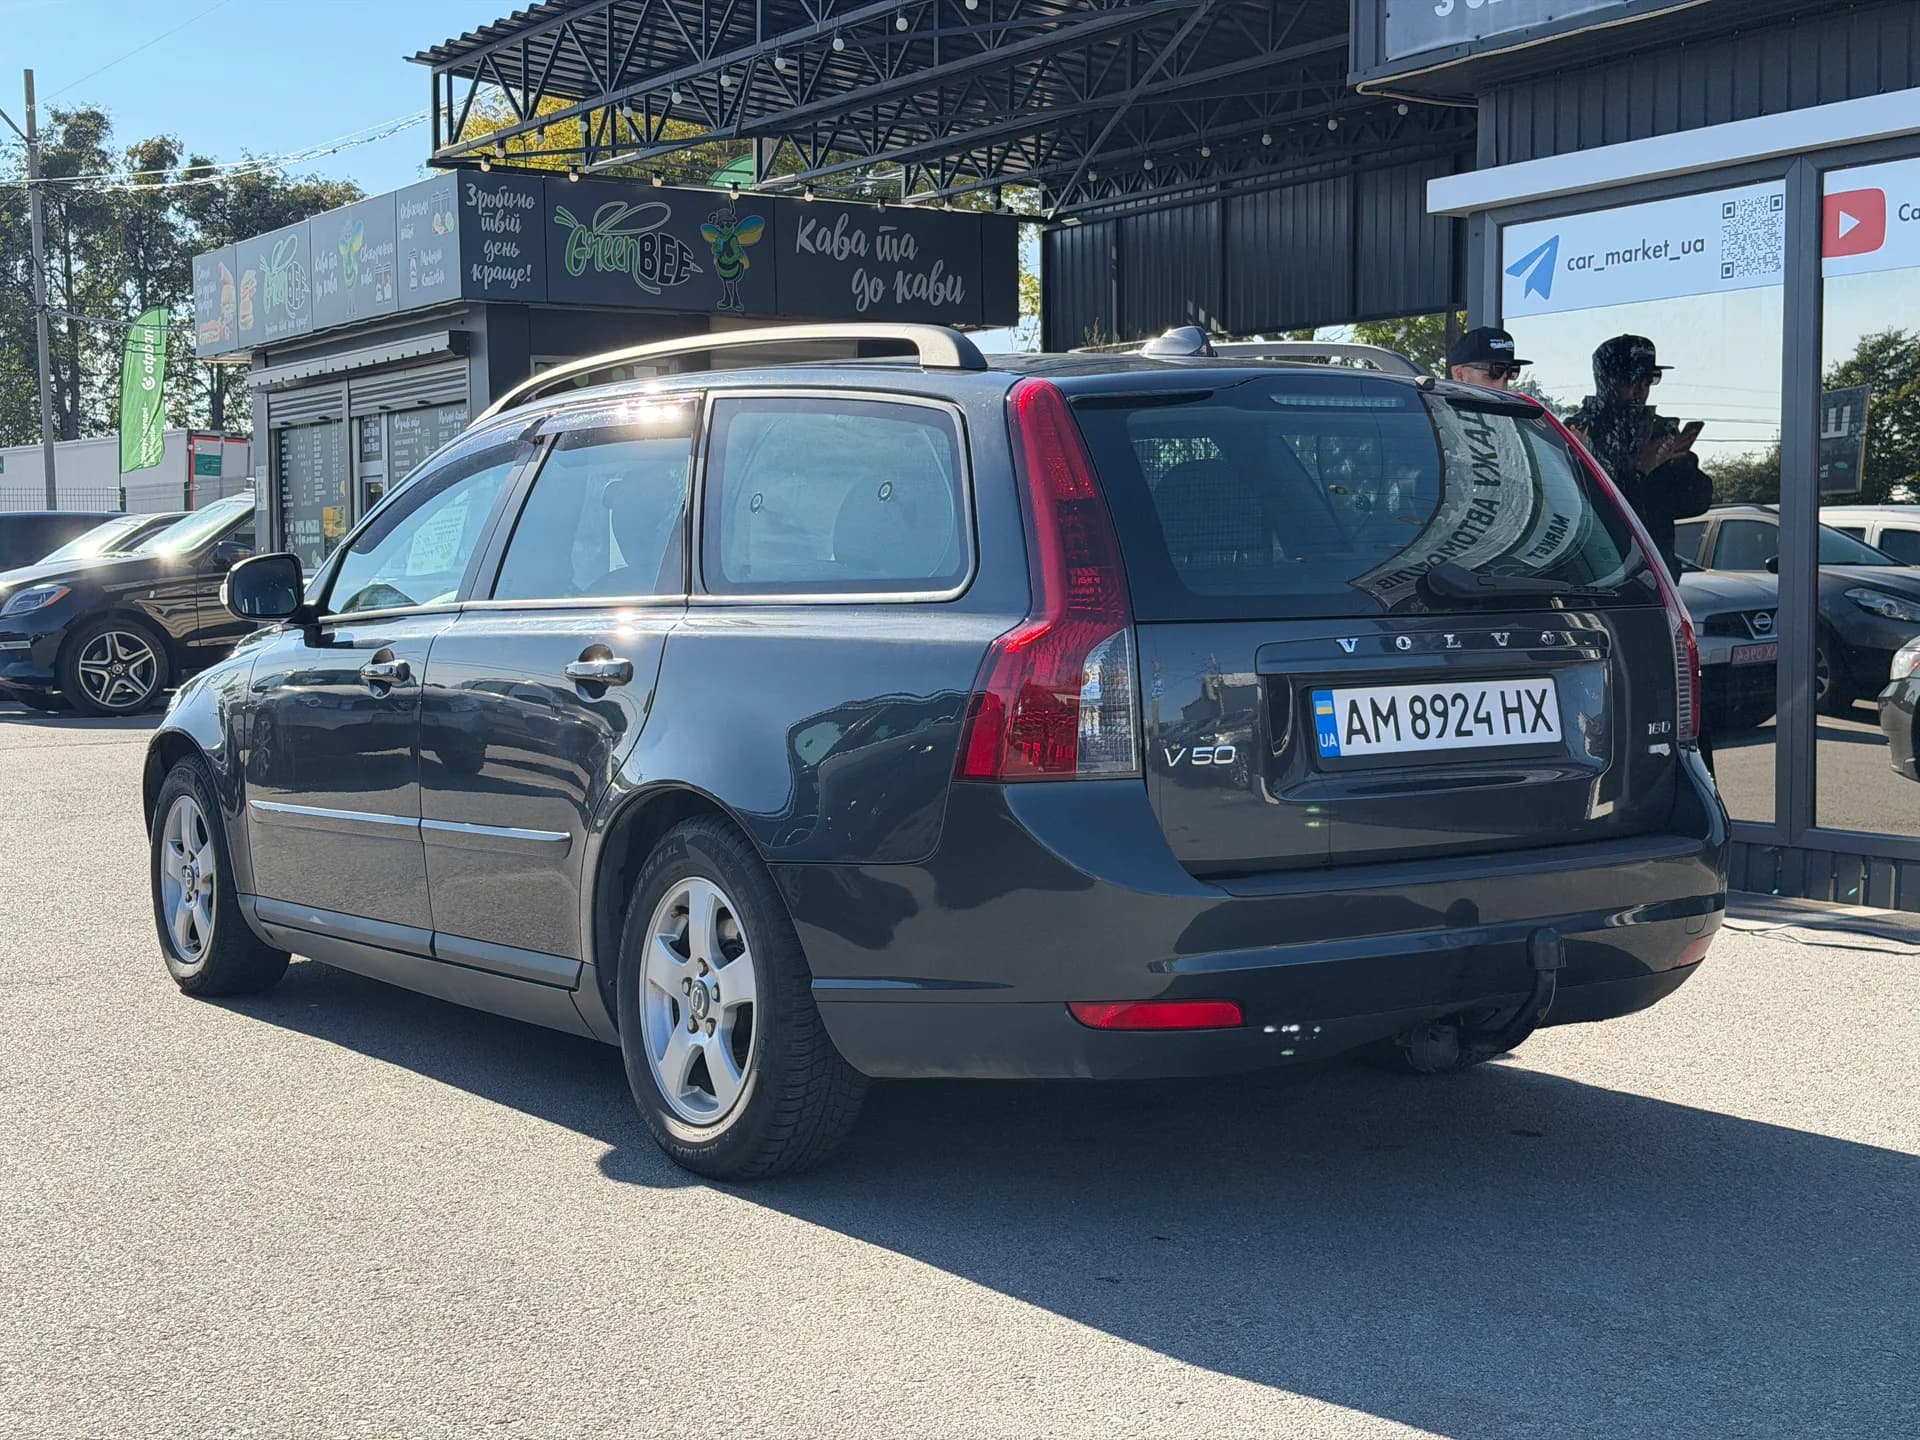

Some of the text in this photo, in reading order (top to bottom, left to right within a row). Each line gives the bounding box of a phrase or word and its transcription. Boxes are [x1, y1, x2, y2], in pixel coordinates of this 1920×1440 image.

[466, 183, 535, 211] Зробимо
[481, 211, 521, 233] твій
[484, 239, 520, 263] день
[796, 213, 919, 263] Кава та
[1567, 237, 1705, 272] car_market_ua
[471, 264, 532, 290] краще!
[852, 259, 966, 313] до кави
[1336, 630, 1556, 653] VOLVO
[1345, 688, 1553, 745] AM 8924 HX
[1319, 732, 1338, 748] UA
